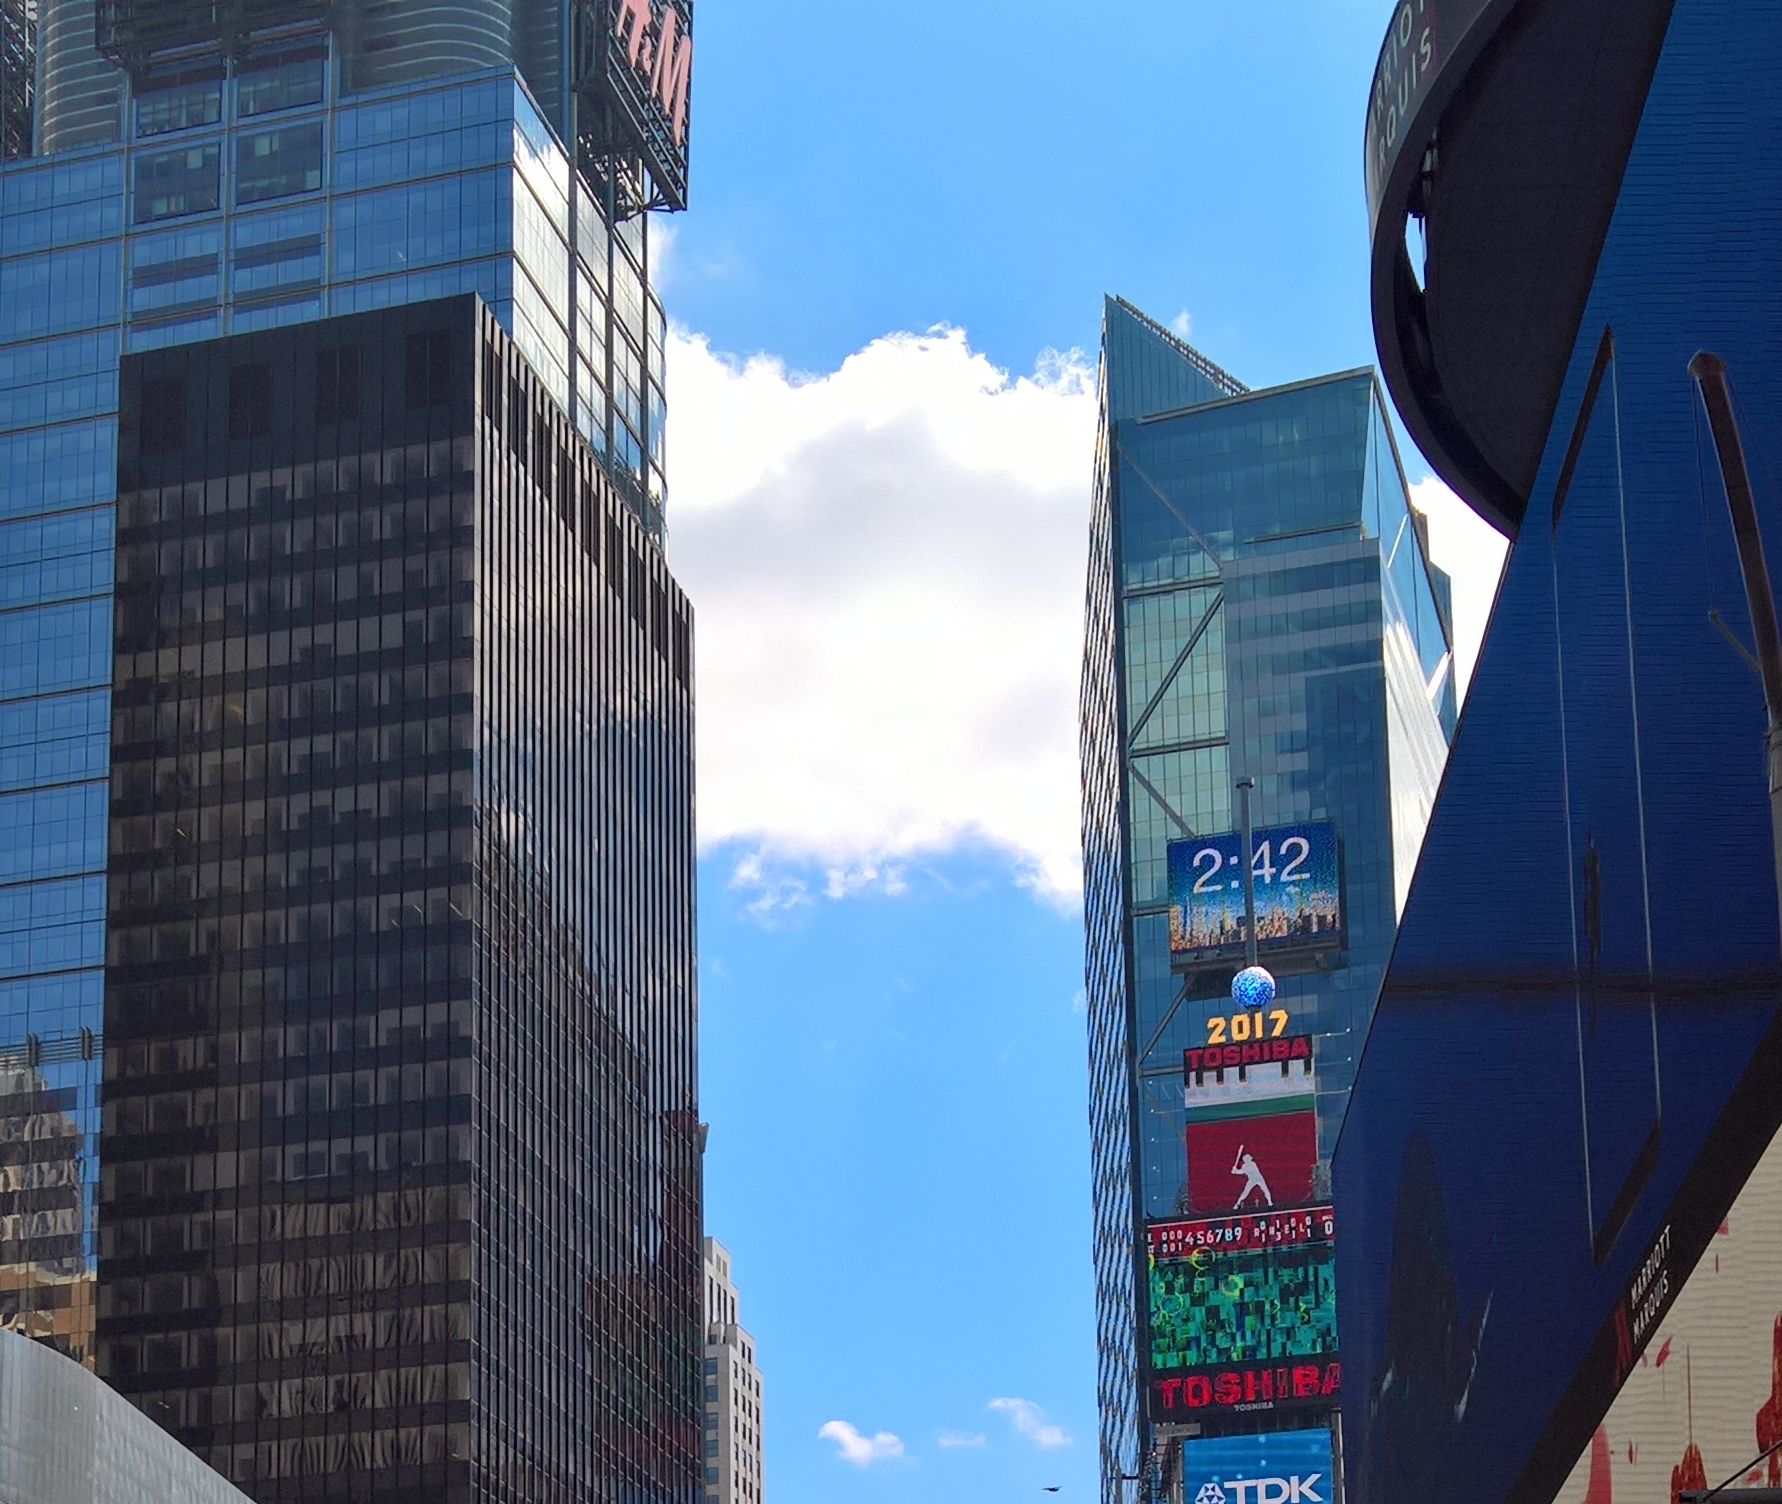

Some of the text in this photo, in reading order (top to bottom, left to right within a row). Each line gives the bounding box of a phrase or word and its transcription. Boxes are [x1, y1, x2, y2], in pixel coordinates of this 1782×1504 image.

[1192, 837, 1310, 894] 2:42
[1206, 1010, 1289, 1045] 2017
[1186, 1035, 1310, 1070] TOSHIBA
[1630, 1225, 1673, 1310] MARRIOTT
[1631, 1271, 1671, 1343] MARQUIS
[1233, 1401, 1275, 1412] TOSHIBA
